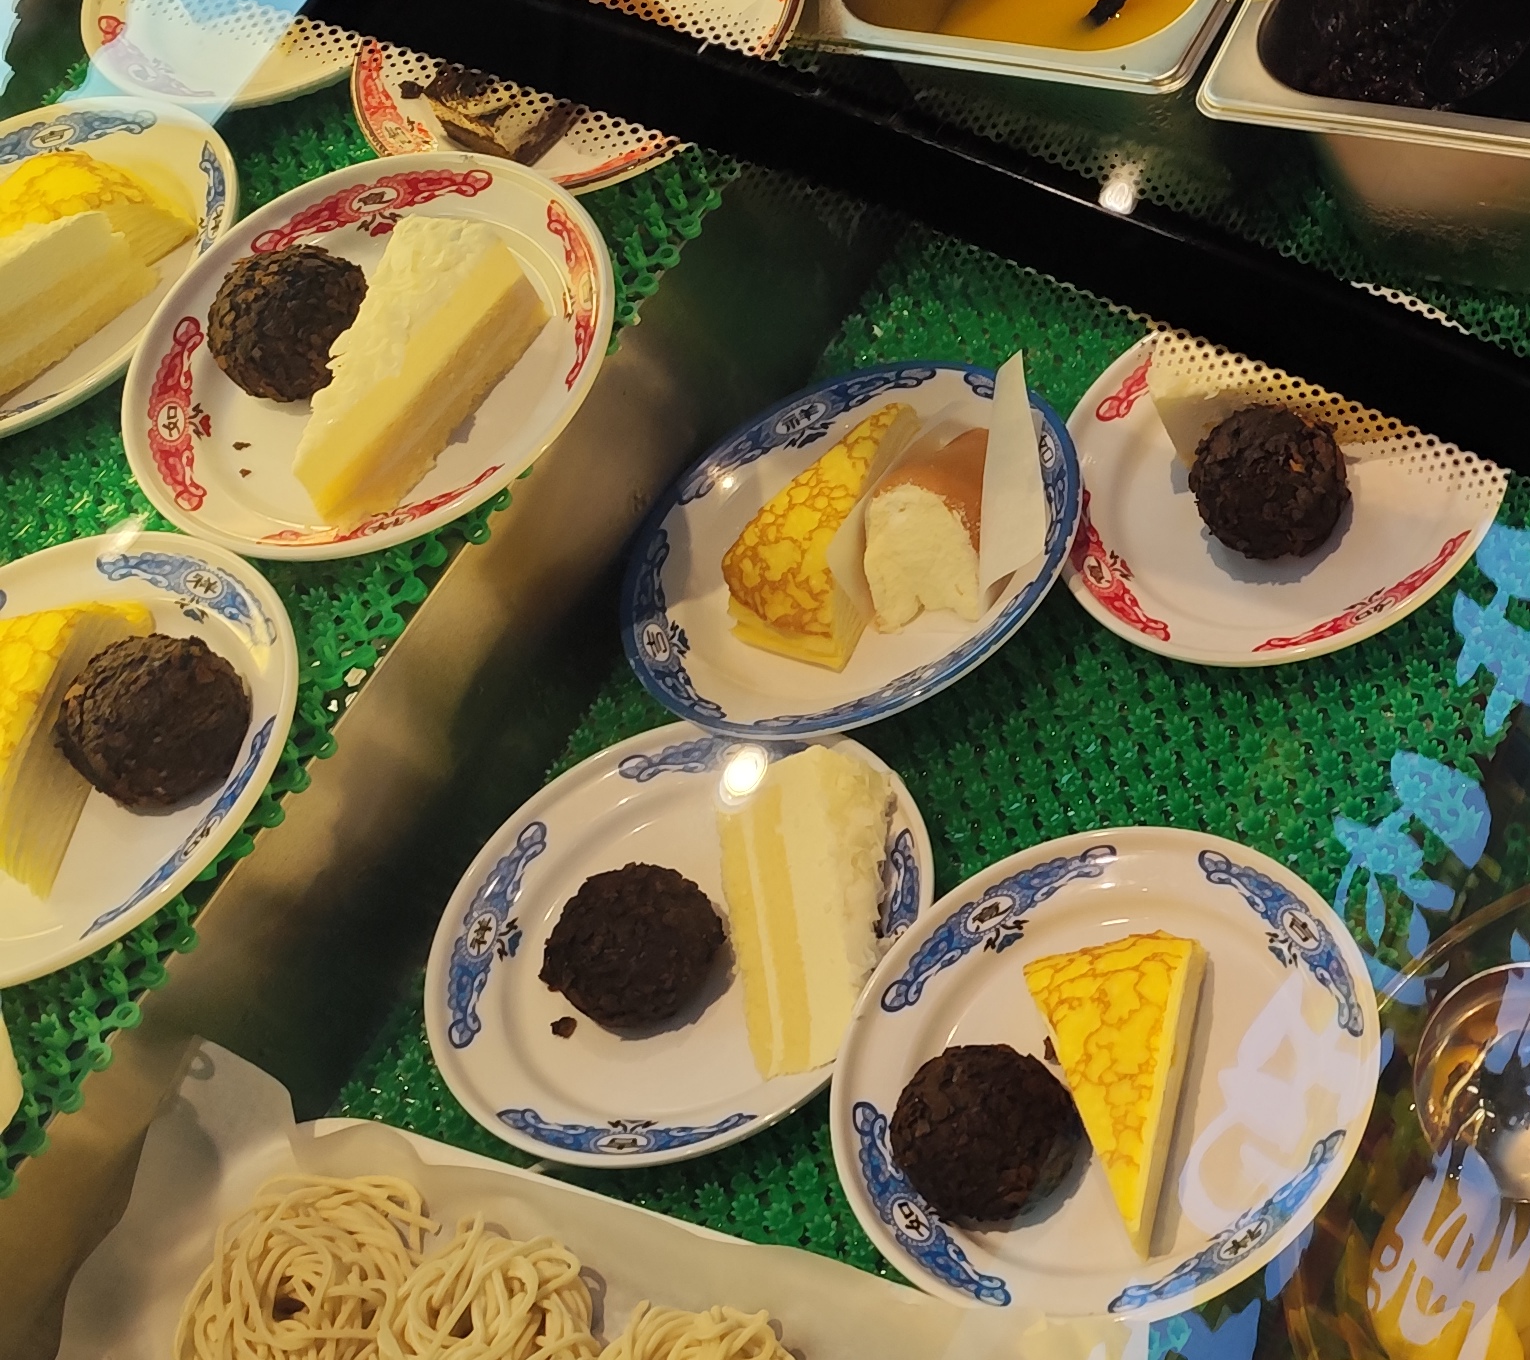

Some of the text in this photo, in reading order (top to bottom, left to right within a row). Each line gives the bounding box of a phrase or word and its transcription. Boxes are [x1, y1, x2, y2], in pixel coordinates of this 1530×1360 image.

[161, 404, 182, 437] 如
[645, 626, 668, 662] 吉
[1288, 910, 1317, 943] 吉
[897, 1201, 925, 1238] 如
